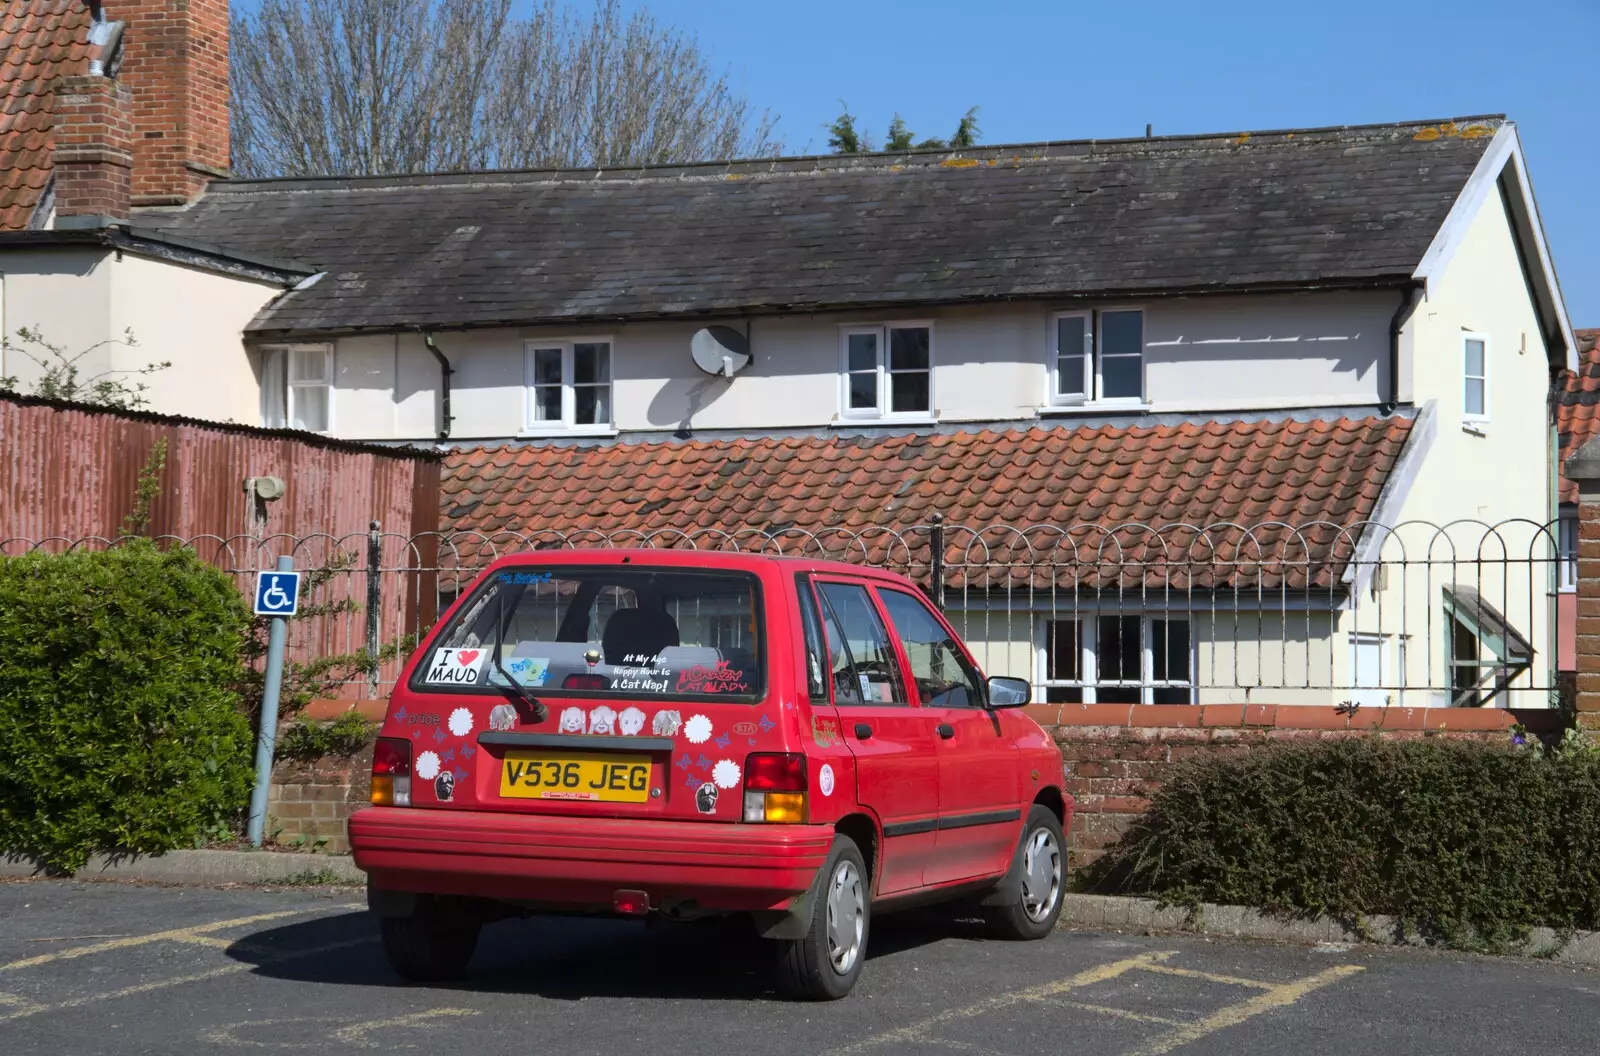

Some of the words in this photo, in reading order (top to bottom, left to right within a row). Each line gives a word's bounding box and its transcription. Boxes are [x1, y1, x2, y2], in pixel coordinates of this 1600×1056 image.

[439, 650, 452, 666] I
[623, 654, 634, 662] At
[635, 654, 650, 667] My
[651, 654, 667, 665] Age
[428, 668, 478, 682] MAUD
[613, 667, 639, 679] Happy
[640, 667, 660, 675] Hour
[661, 667, 671, 676] Is
[610, 679, 618, 689] A
[620, 679, 640, 689] Cat
[641, 679, 669, 693] Nap!
[676, 680, 702, 693] CAT
[713, 680, 748, 693] LADY
[407, 713, 441, 726] pride
[737, 724, 755, 733] KIA
[506, 761, 581, 788] V536
[588, 764, 648, 791] JEG
